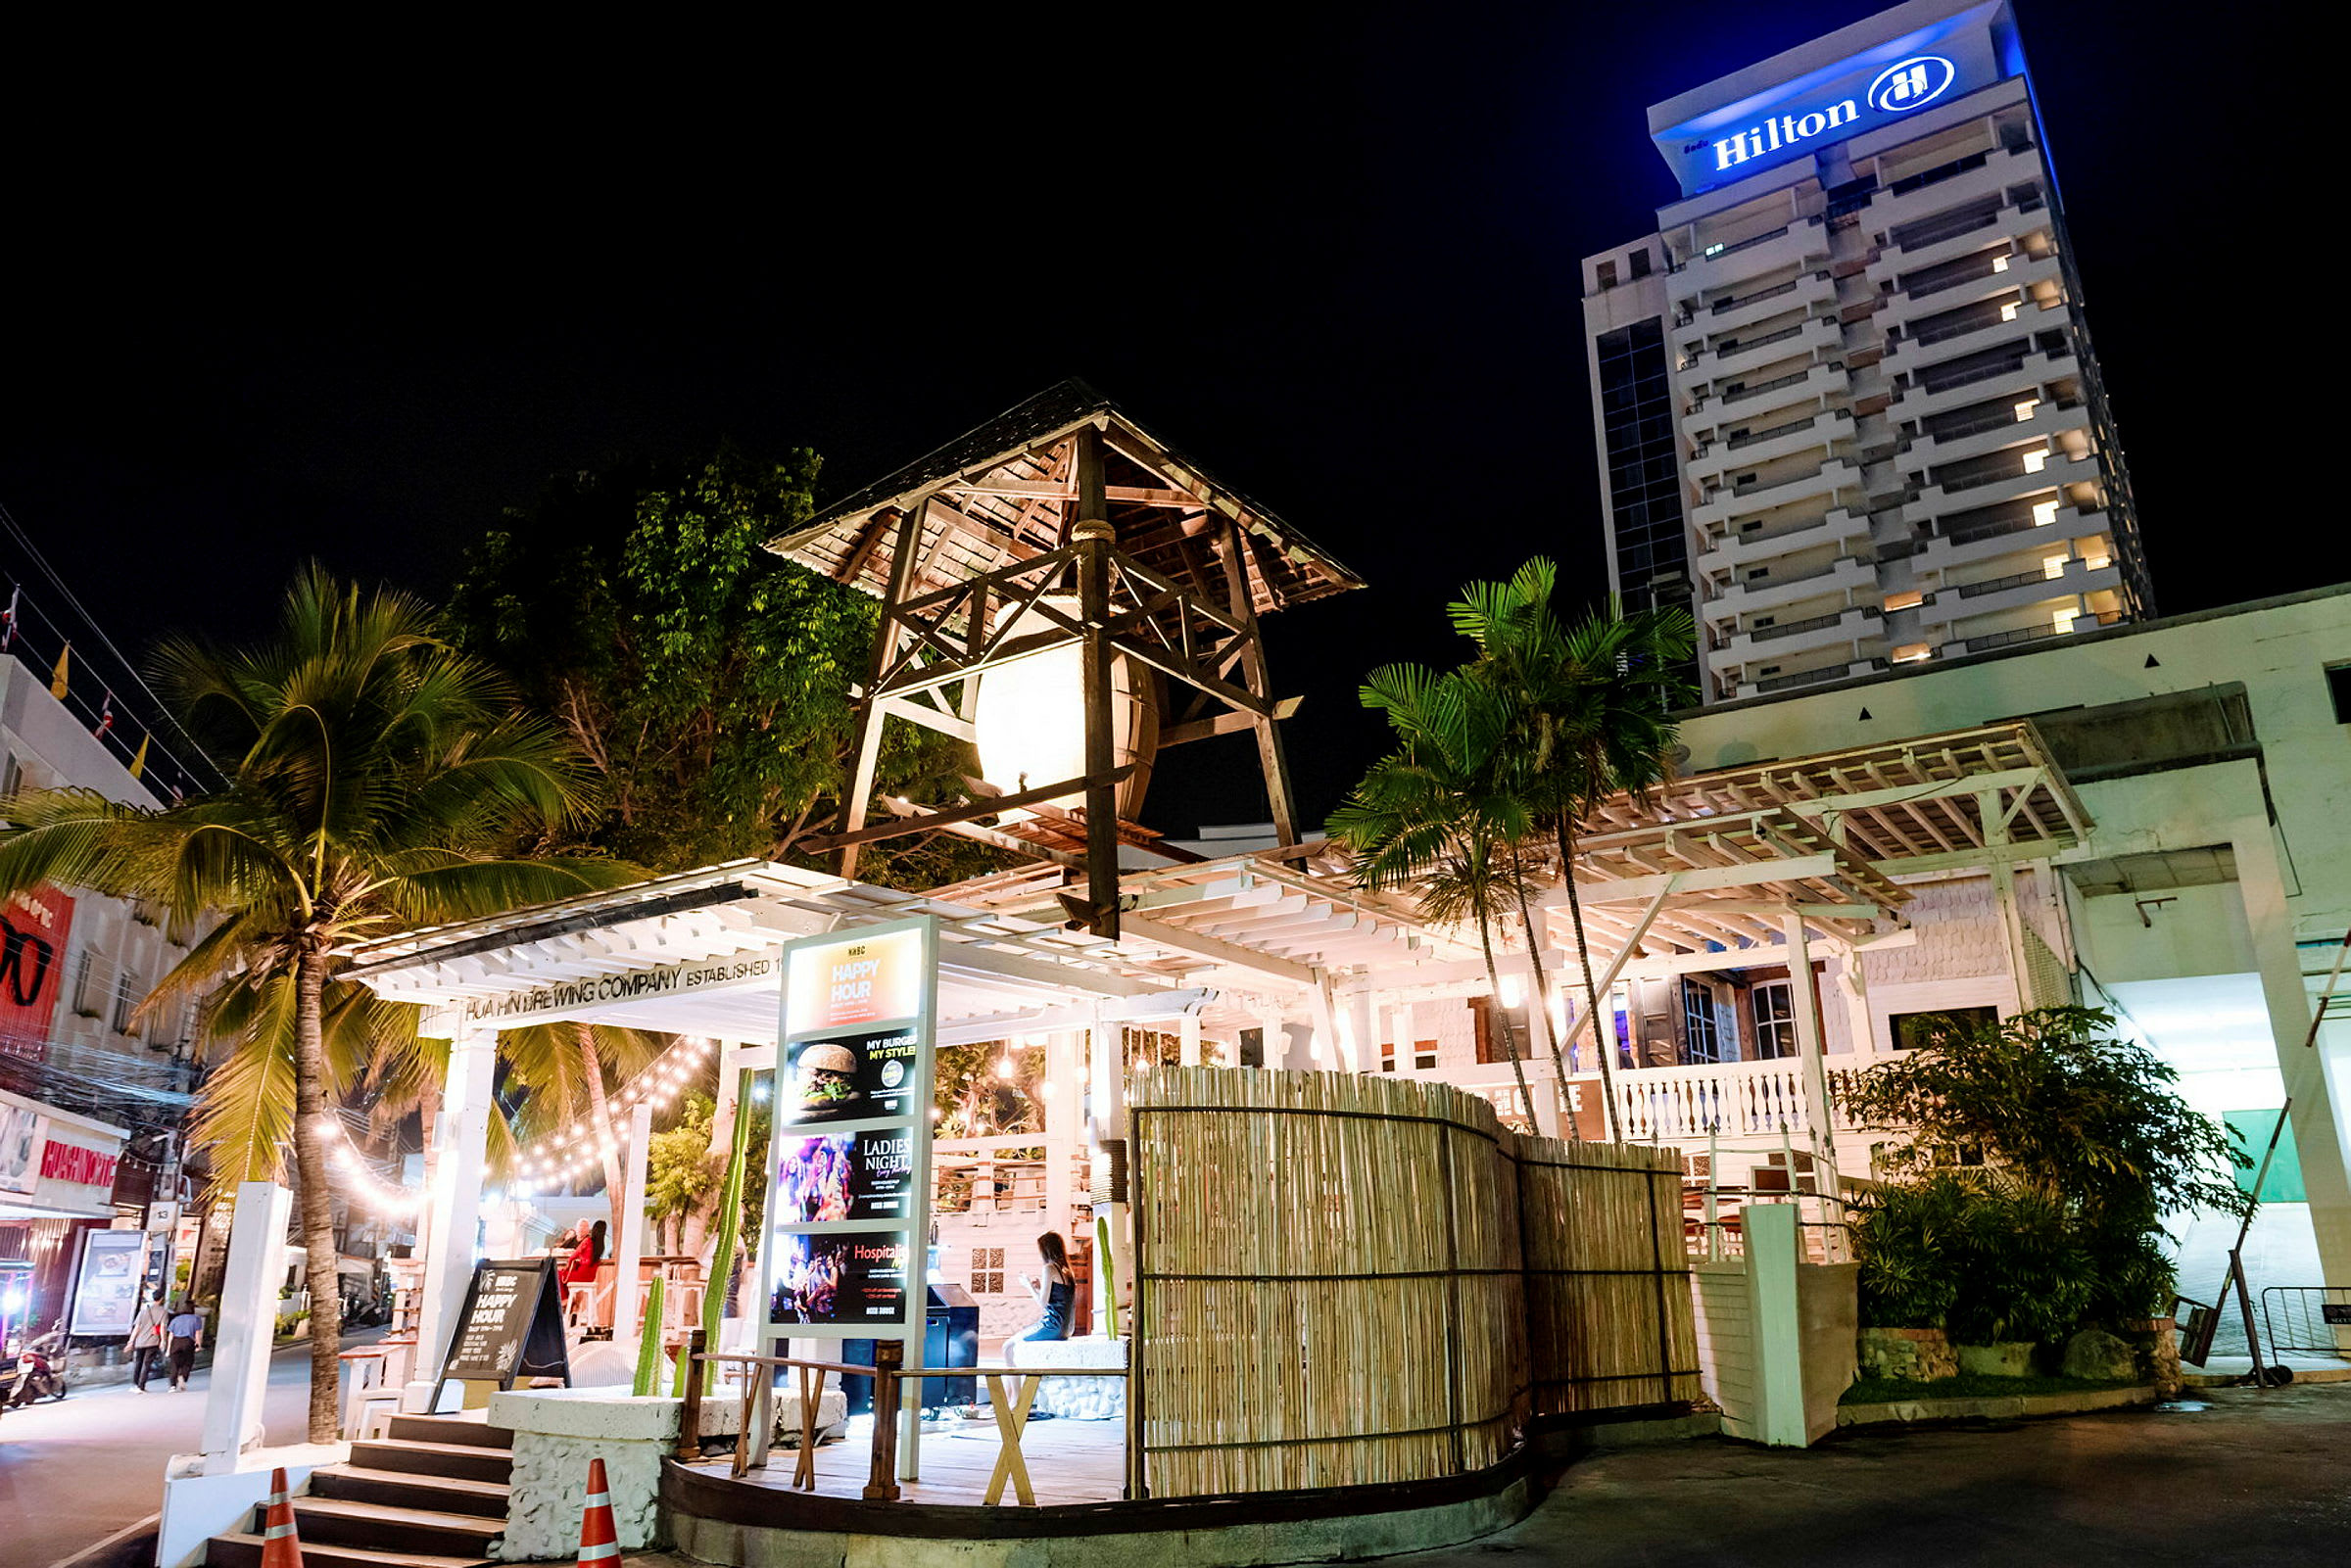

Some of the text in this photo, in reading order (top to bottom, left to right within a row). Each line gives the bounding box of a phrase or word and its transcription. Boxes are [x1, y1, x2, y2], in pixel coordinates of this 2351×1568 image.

[1713, 99, 1860, 171] Hilton
[831, 959, 881, 983] HAPPY
[465, 999, 494, 1021] HUA
[497, 994, 520, 1017] HIN
[523, 981, 595, 1014] BREWING
[599, 968, 683, 1000] COMPANY
[686, 959, 770, 987] ESTABLISHED
[831, 980, 872, 1002] HOUR
[867, 1040, 882, 1050] MY
[870, 1050, 885, 1060] MY
[863, 1138, 910, 1156] LADIES
[865, 1156, 908, 1170] NIGHT
[475, 1294, 518, 1308] HAPPY
[470, 1308, 505, 1324] HOUR
